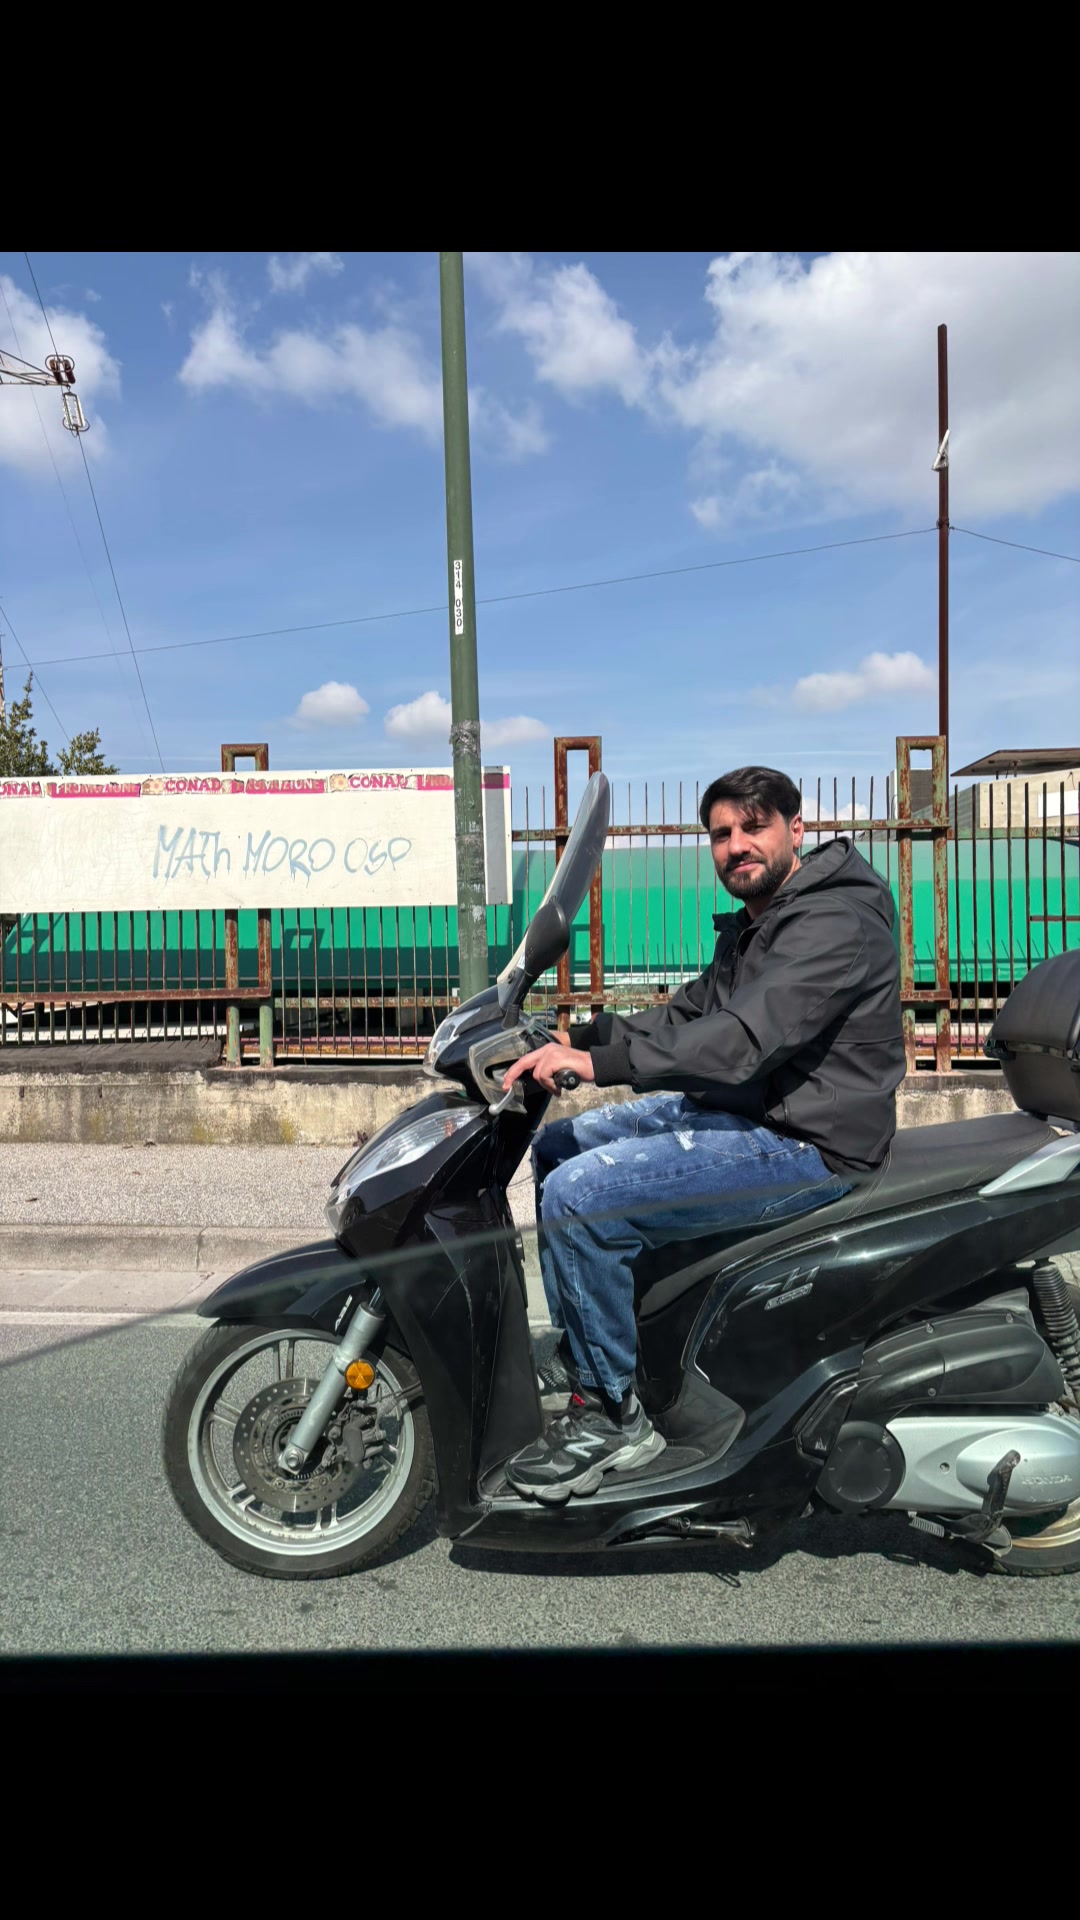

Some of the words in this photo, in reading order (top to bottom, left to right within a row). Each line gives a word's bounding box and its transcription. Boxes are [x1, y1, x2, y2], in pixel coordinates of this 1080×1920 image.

[455, 598, 463, 627] 030
[165, 778, 222, 792] CONAD
[243, 830, 336, 882] MORO
[1021, 1474, 1073, 1486] HONDA
